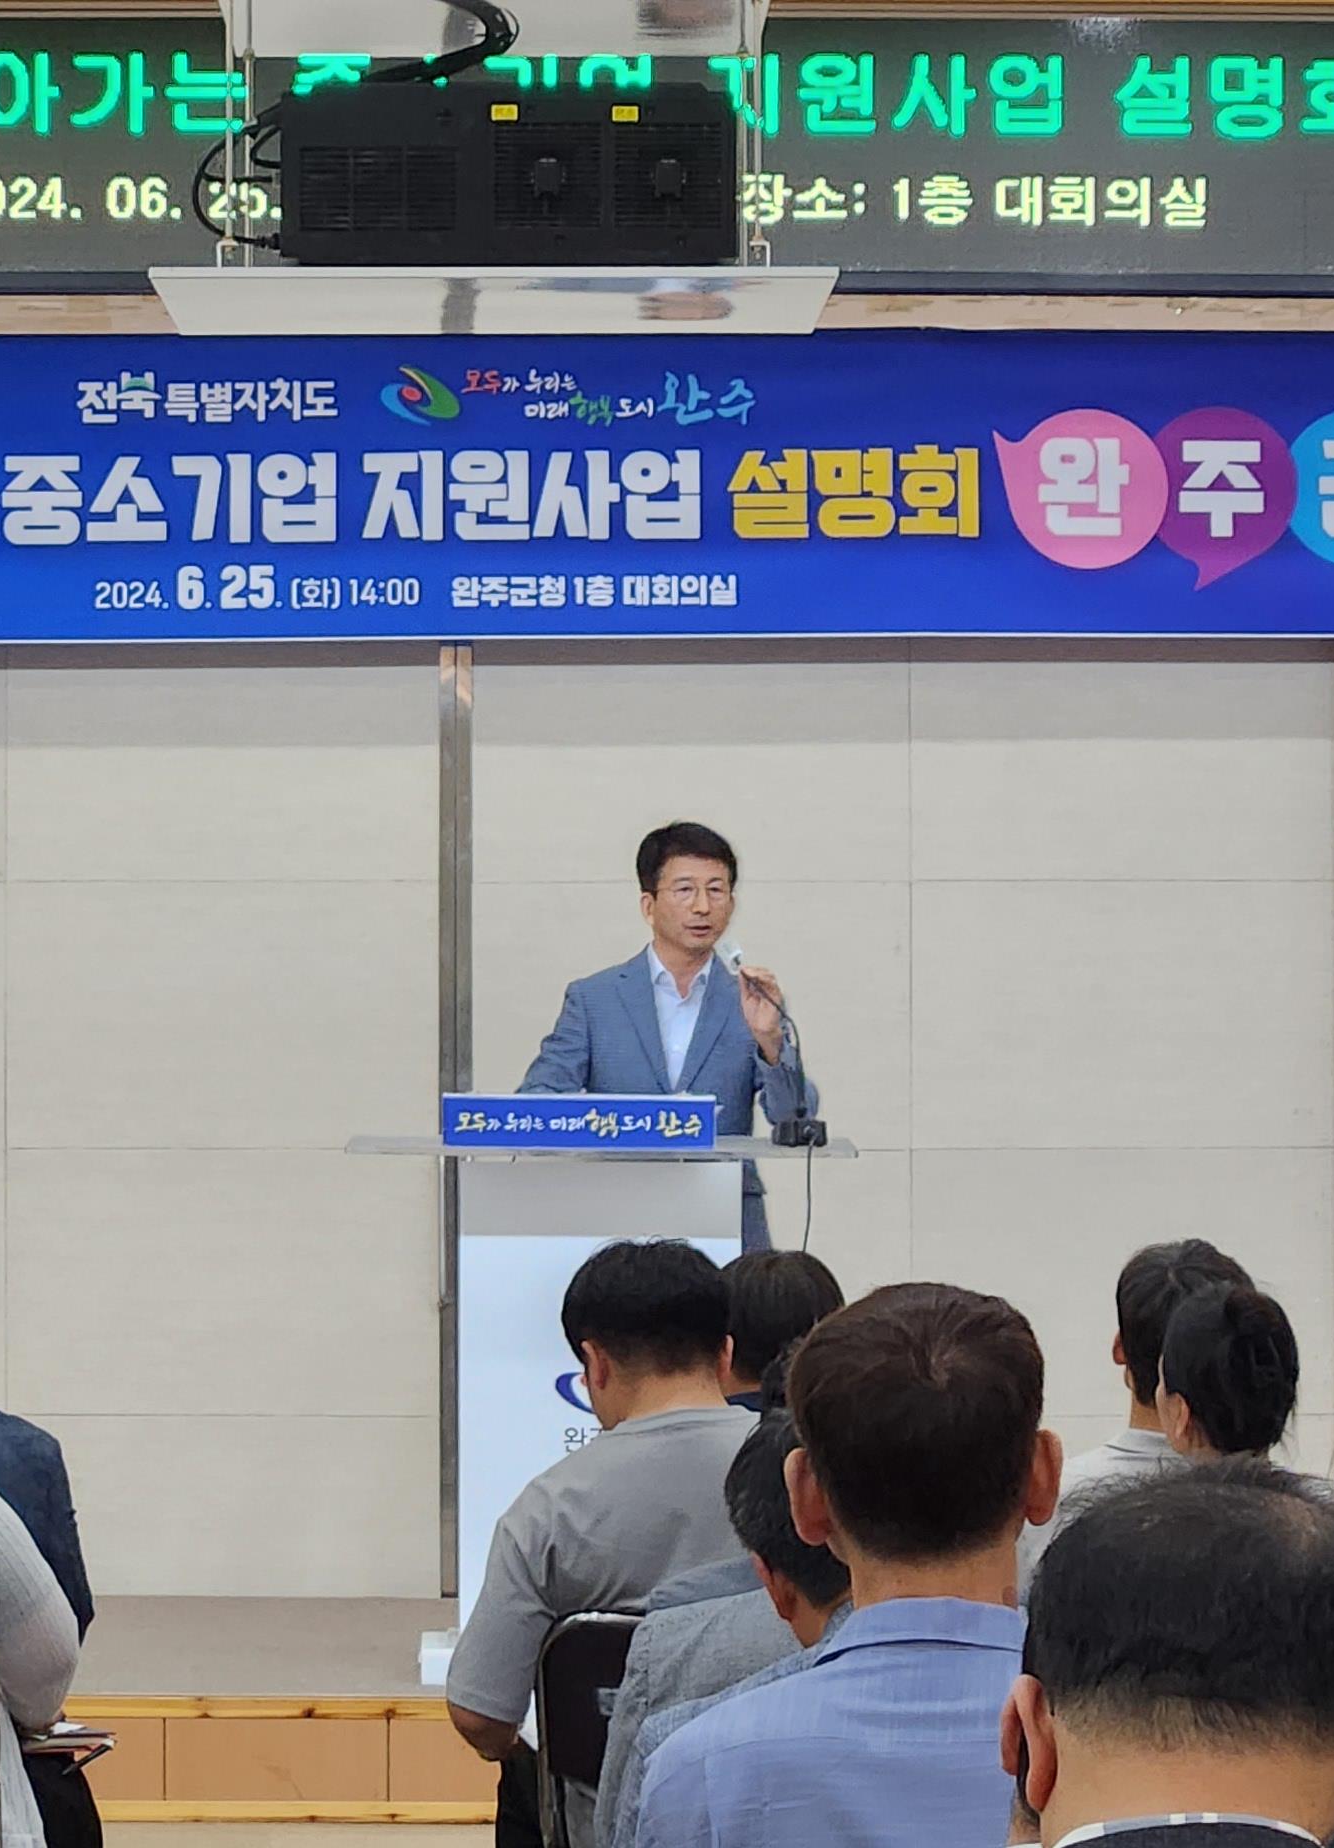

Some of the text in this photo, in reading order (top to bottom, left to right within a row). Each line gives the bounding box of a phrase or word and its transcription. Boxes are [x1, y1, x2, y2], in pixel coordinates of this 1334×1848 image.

[708, 53, 1064, 139] 지원사업
[106, 177, 183, 220] 06.
[739, 172, 1210, 229] 장소: 1층 대회의실
[461, 369, 576, 394] 모두가 누리는
[524, 400, 569, 419] 미래
[616, 398, 654, 418] 도시
[2, 450, 338, 546] 중소기업
[361, 448, 703, 541] 지원사업
[727, 444, 981, 540] 설명회
[94, 564, 737, 611] 2024. 6. 25. (화) 14:00 완주군청 1층 대회의실
[454, 1111, 501, 1133] 모두가
[620, 1114, 652, 1132] 도시
